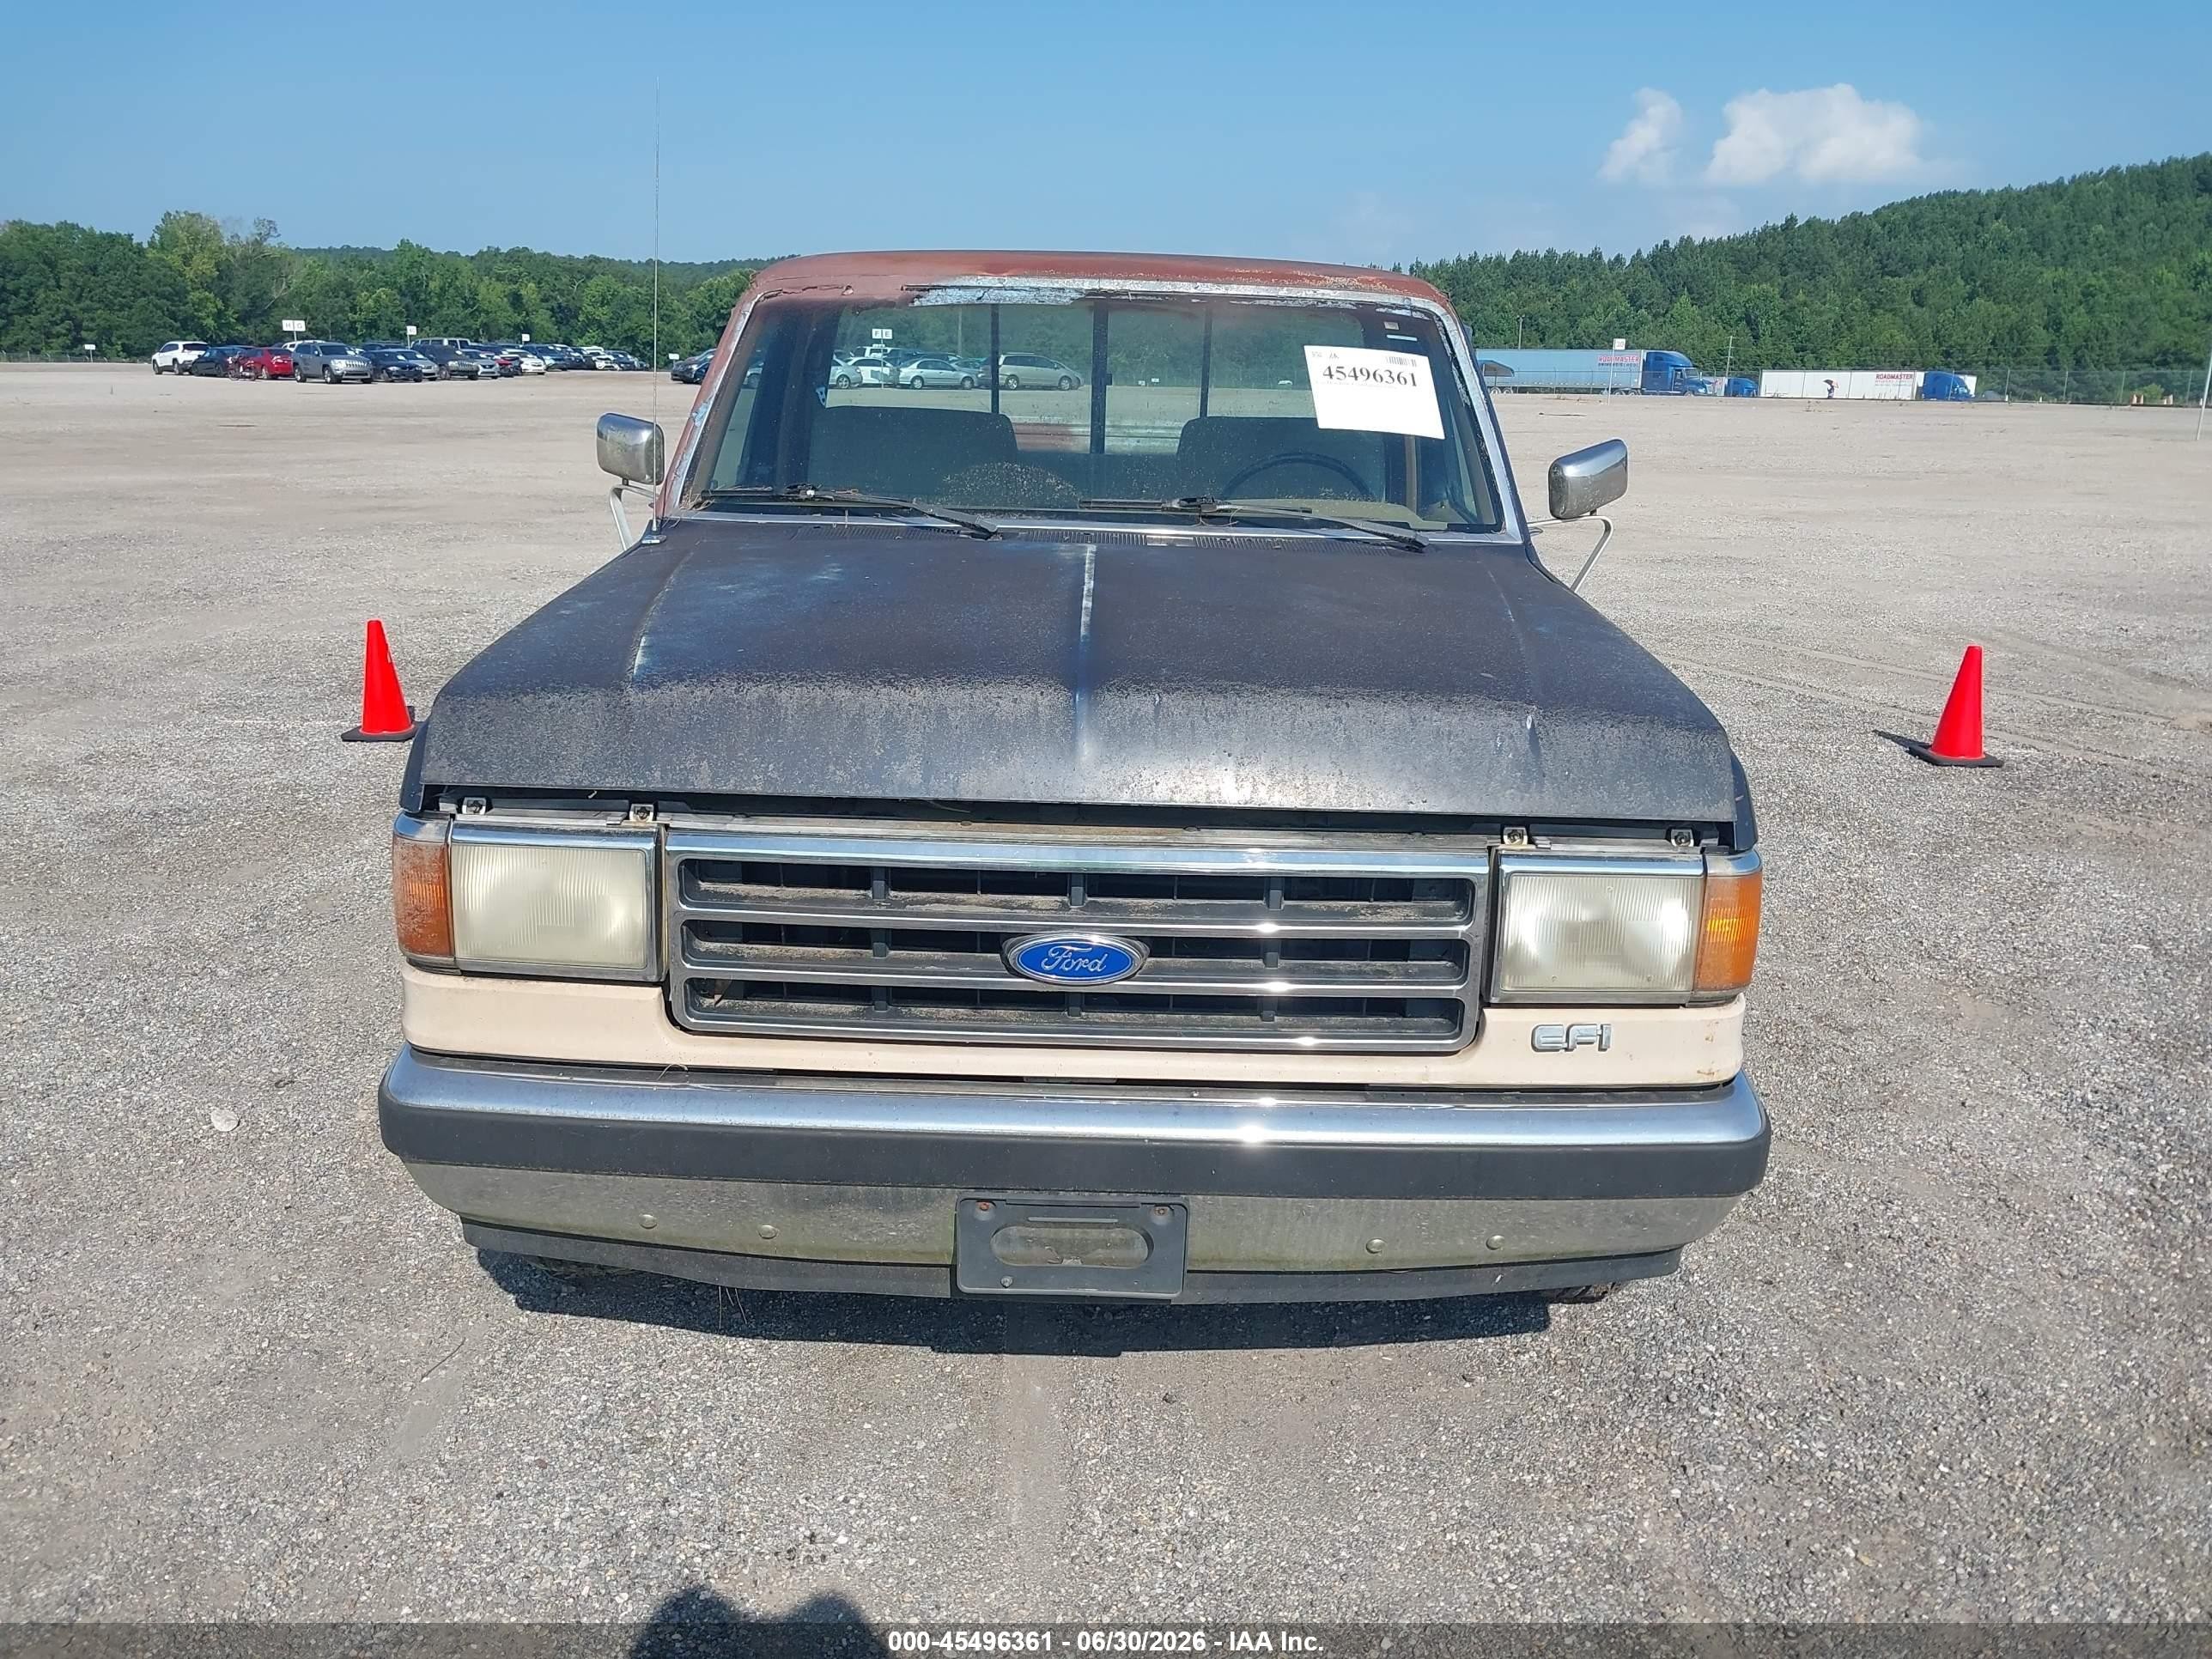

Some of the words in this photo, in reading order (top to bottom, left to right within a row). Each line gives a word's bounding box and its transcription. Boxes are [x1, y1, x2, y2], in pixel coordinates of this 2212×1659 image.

[1322, 365, 1418, 387] 45496361
[1041, 945, 1108, 972] Ford
[1531, 1024, 1612, 1053] EFI
